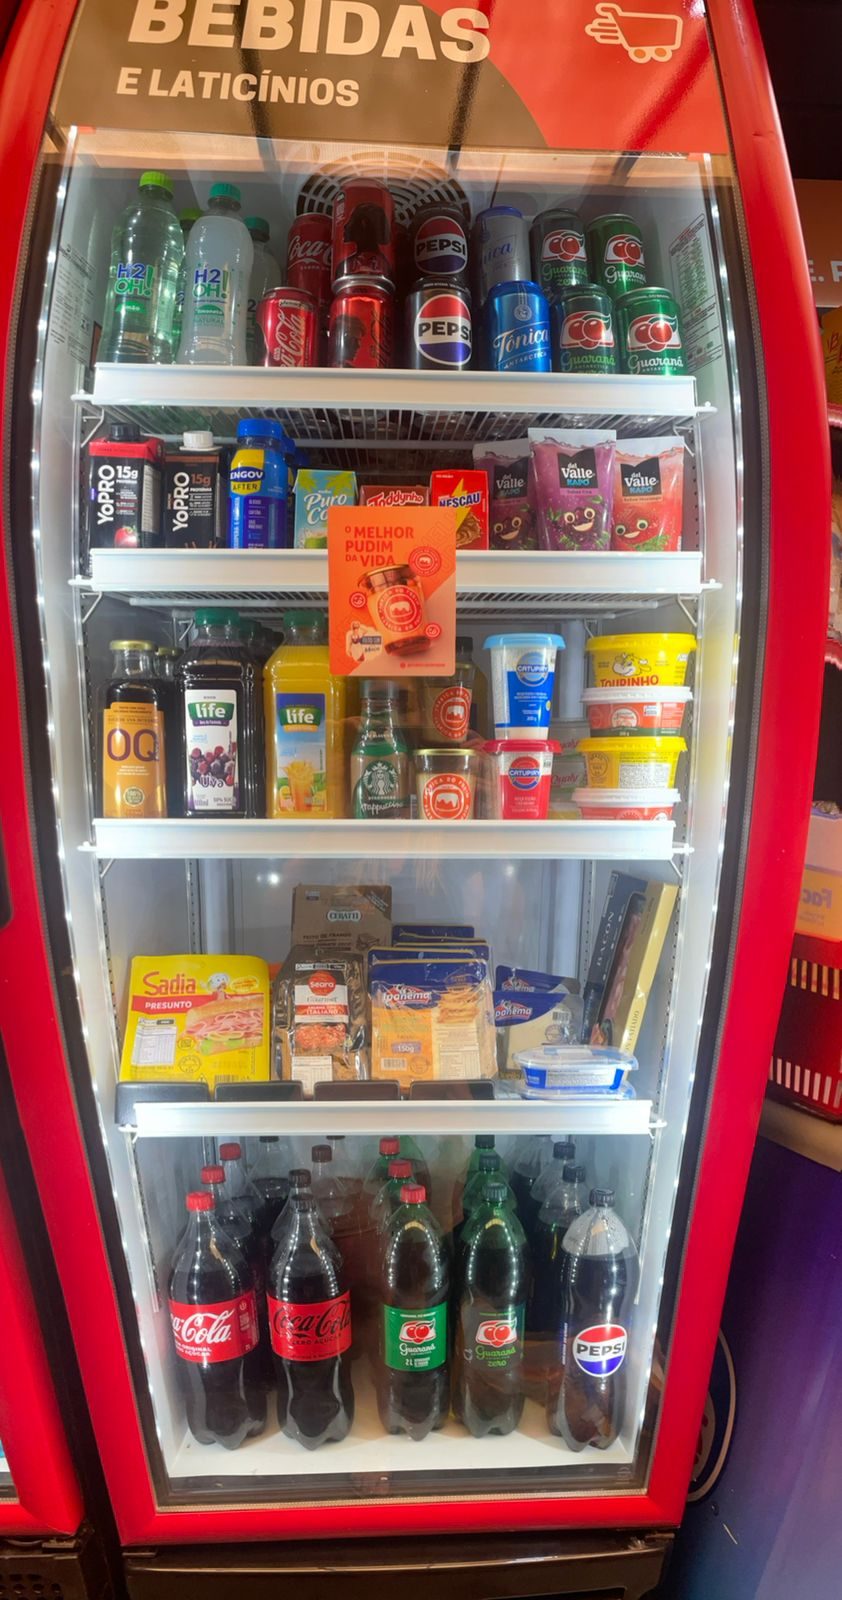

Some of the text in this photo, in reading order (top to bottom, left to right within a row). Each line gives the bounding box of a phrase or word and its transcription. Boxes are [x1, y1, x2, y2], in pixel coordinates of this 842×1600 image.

[128, 0, 490, 63] BEBIDAS
[116, 67, 360, 107] E LATICÍNIOS
[288, 235, 332, 261] Coca-C
[416, 238, 466, 257] PEPSI
[117, 263, 145, 279] H2
[194, 268, 221, 284] H2
[114, 264, 154, 297] OH!
[192, 270, 229, 299] OH!
[493, 328, 549, 362] Tônica
[560, 350, 616, 372] Guaraná
[628, 354, 684, 375] Guaraná
[116, 465, 139, 480] 15g
[191, 473, 211, 487] 15g
[230, 470, 264, 480] ENGOV
[561, 467, 594, 479] Valle
[232, 483, 258, 491] AFTER
[496, 478, 525, 489] Valle
[623, 476, 657, 488] Valle
[97, 464, 116, 525] YoPRO
[172, 471, 190, 532] YoPRO
[303, 493, 347, 511] Puro
[367, 490, 424, 506] Toddynho
[438, 492, 481, 508] NESCAU
[307, 507, 328, 526] Co
[344, 525, 415, 539] O MELHOR
[345, 540, 393, 553] PUDIM
[345, 554, 396, 567] DA VIDA
[600, 674, 659, 688] TOURINHO
[195, 703, 226, 718] life
[286, 708, 315, 725] life
[106, 727, 160, 763] OQ
[143, 970, 196, 996] Sadia
[145, 1000, 192, 1010] PRESUNTO
[495, 1007, 533, 1017] panema
[399, 1342, 437, 1356] Guaraná
[475, 1345, 516, 1361] Guaraná
[576, 1341, 625, 1357] PEPSI
[487, 1359, 507, 1367] zero
